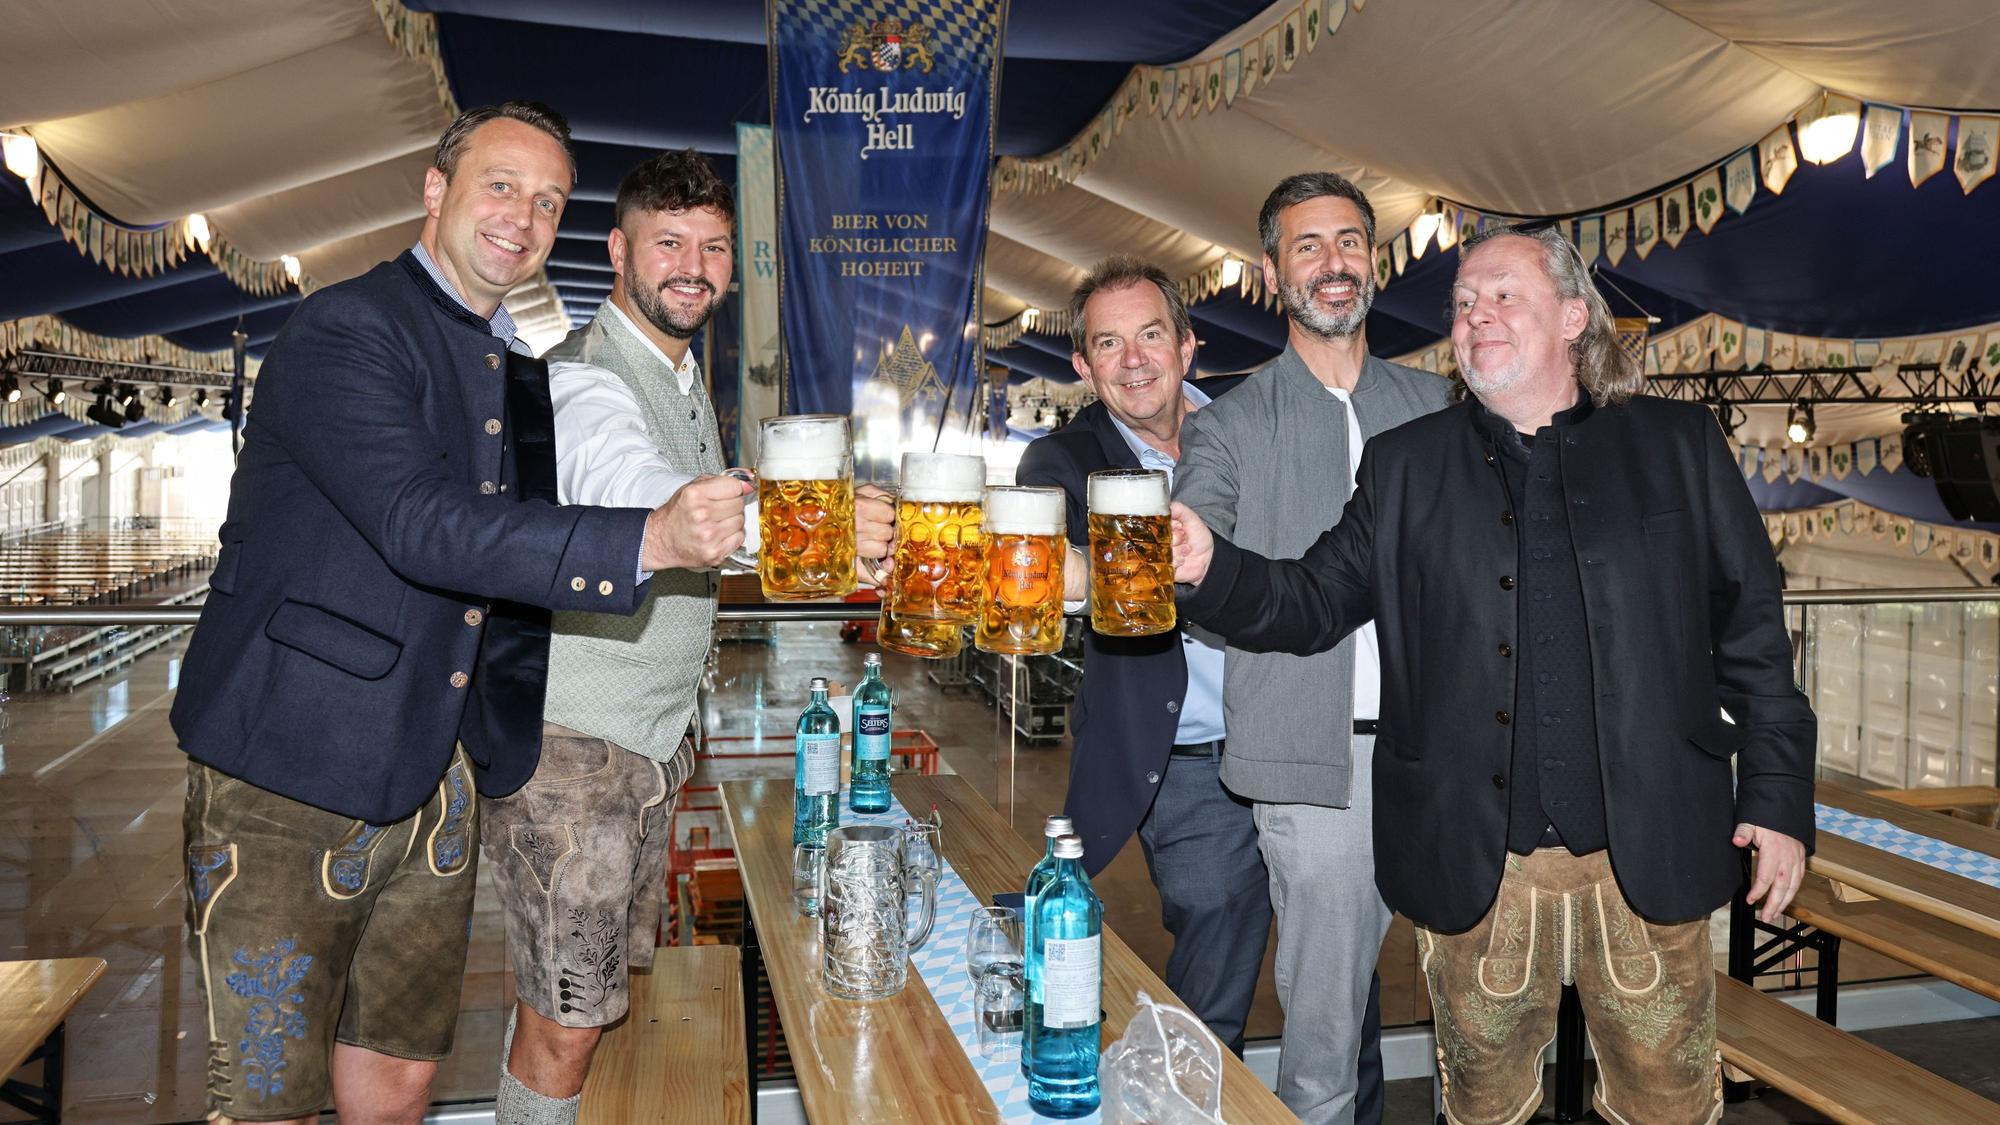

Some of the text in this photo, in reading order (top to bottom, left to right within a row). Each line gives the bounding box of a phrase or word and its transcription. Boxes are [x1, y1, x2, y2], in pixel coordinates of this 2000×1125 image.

[804, 86, 966, 123] König Ludwig
[860, 123, 914, 160] Hell
[832, 213, 929, 230] BIER VON
[809, 234, 957, 253] KÖNIGLICHER
[840, 261, 925, 277] HOHEIT
